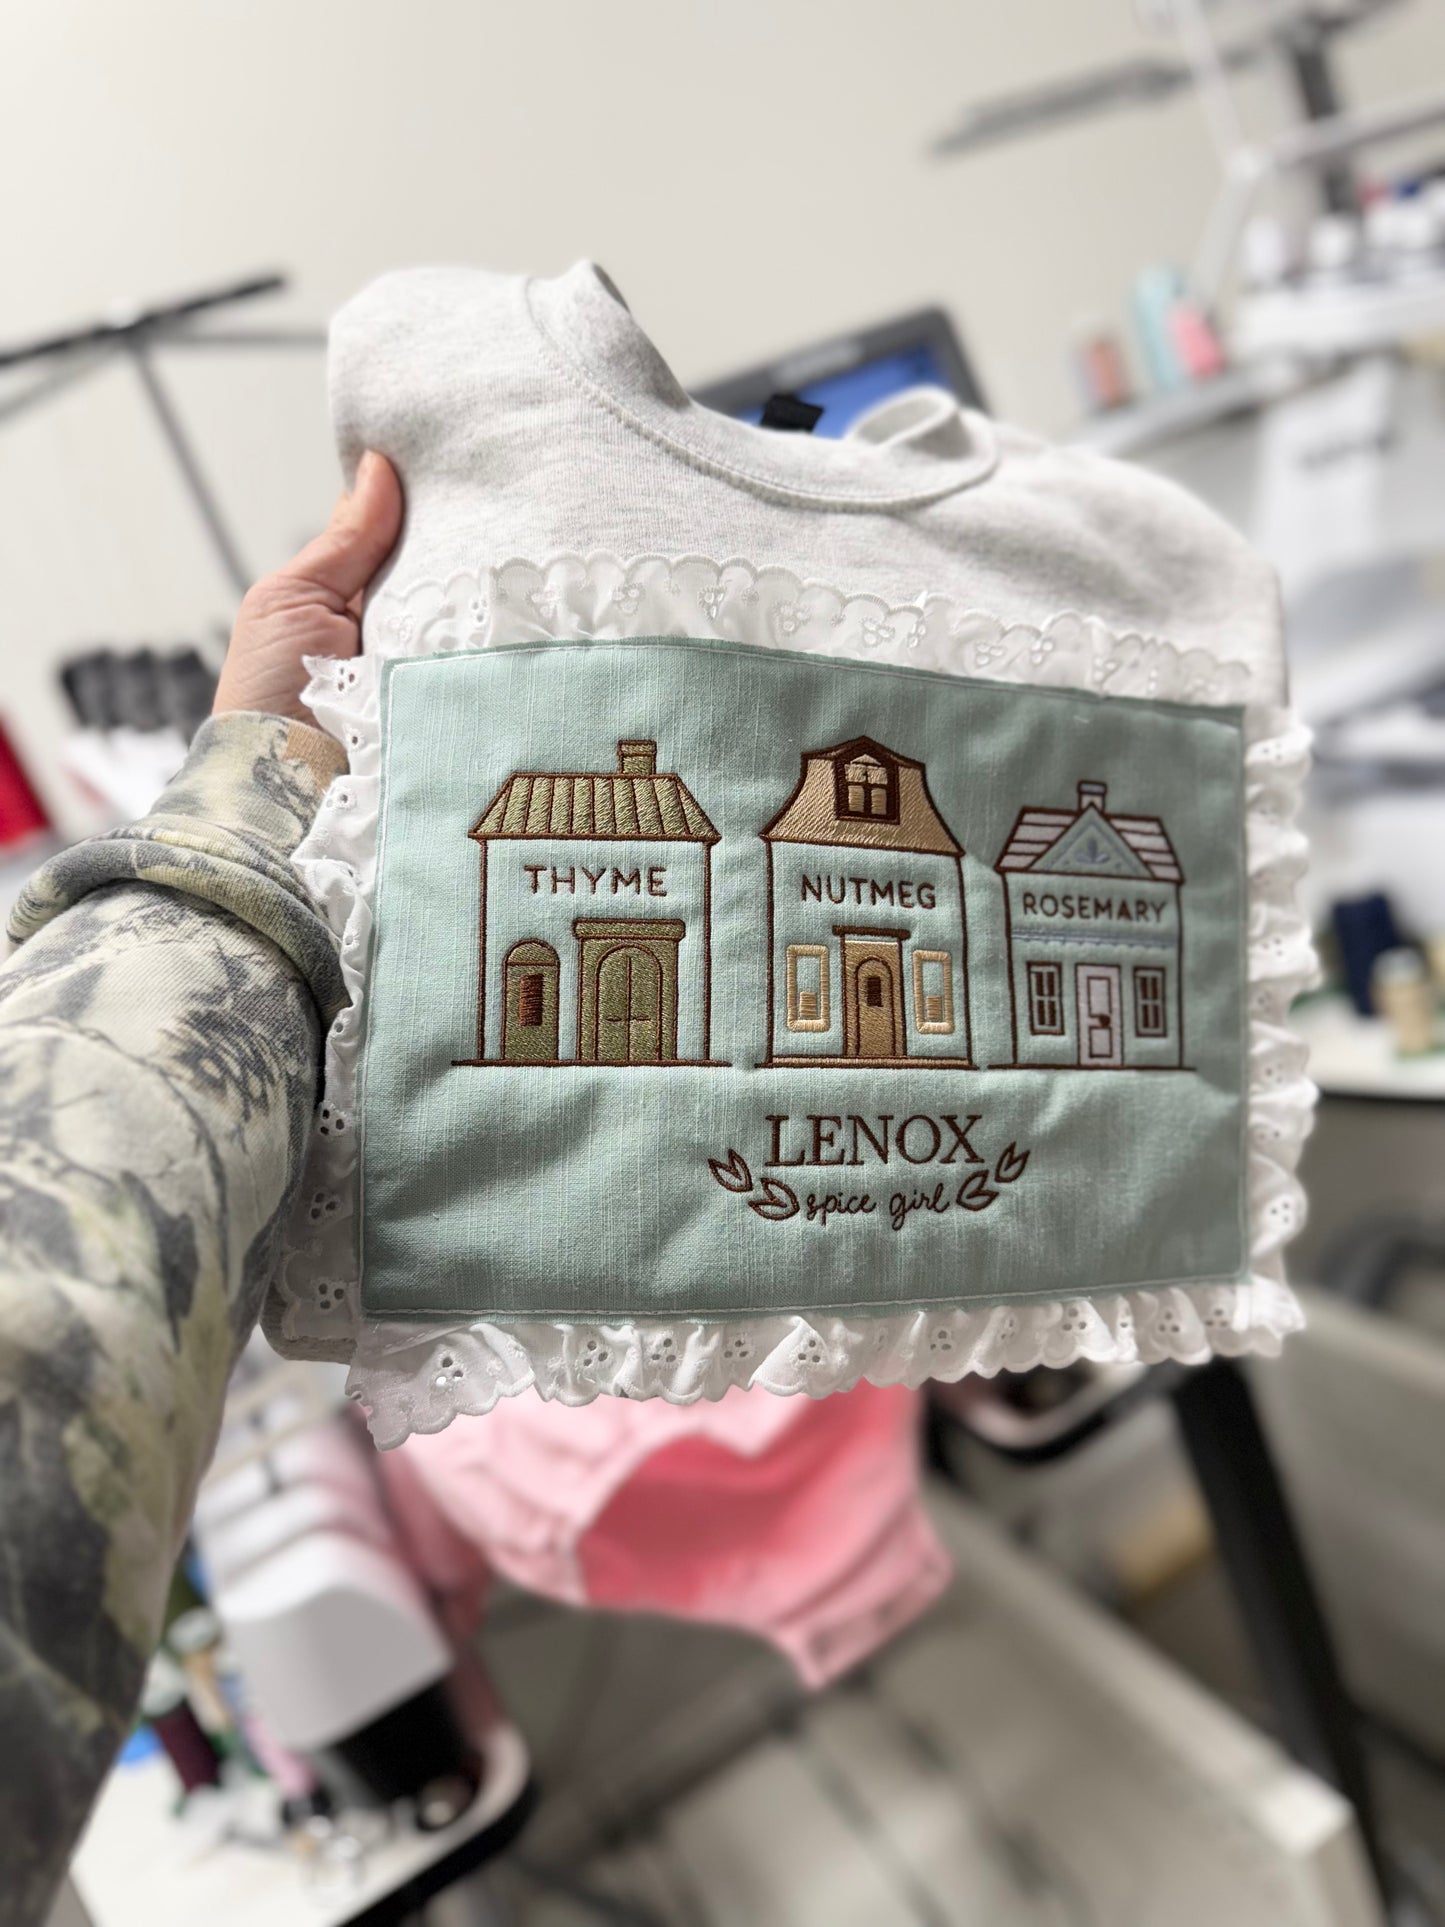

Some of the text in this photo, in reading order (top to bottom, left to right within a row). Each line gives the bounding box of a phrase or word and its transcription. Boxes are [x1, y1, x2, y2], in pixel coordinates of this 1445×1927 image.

[523, 864, 668, 898] THYME
[800, 873, 936, 910] NUTMEG
[1022, 891, 1168, 923] ROSEMARY
[764, 1114, 985, 1167] LENOX
[806, 1182, 951, 1231] spice girl
